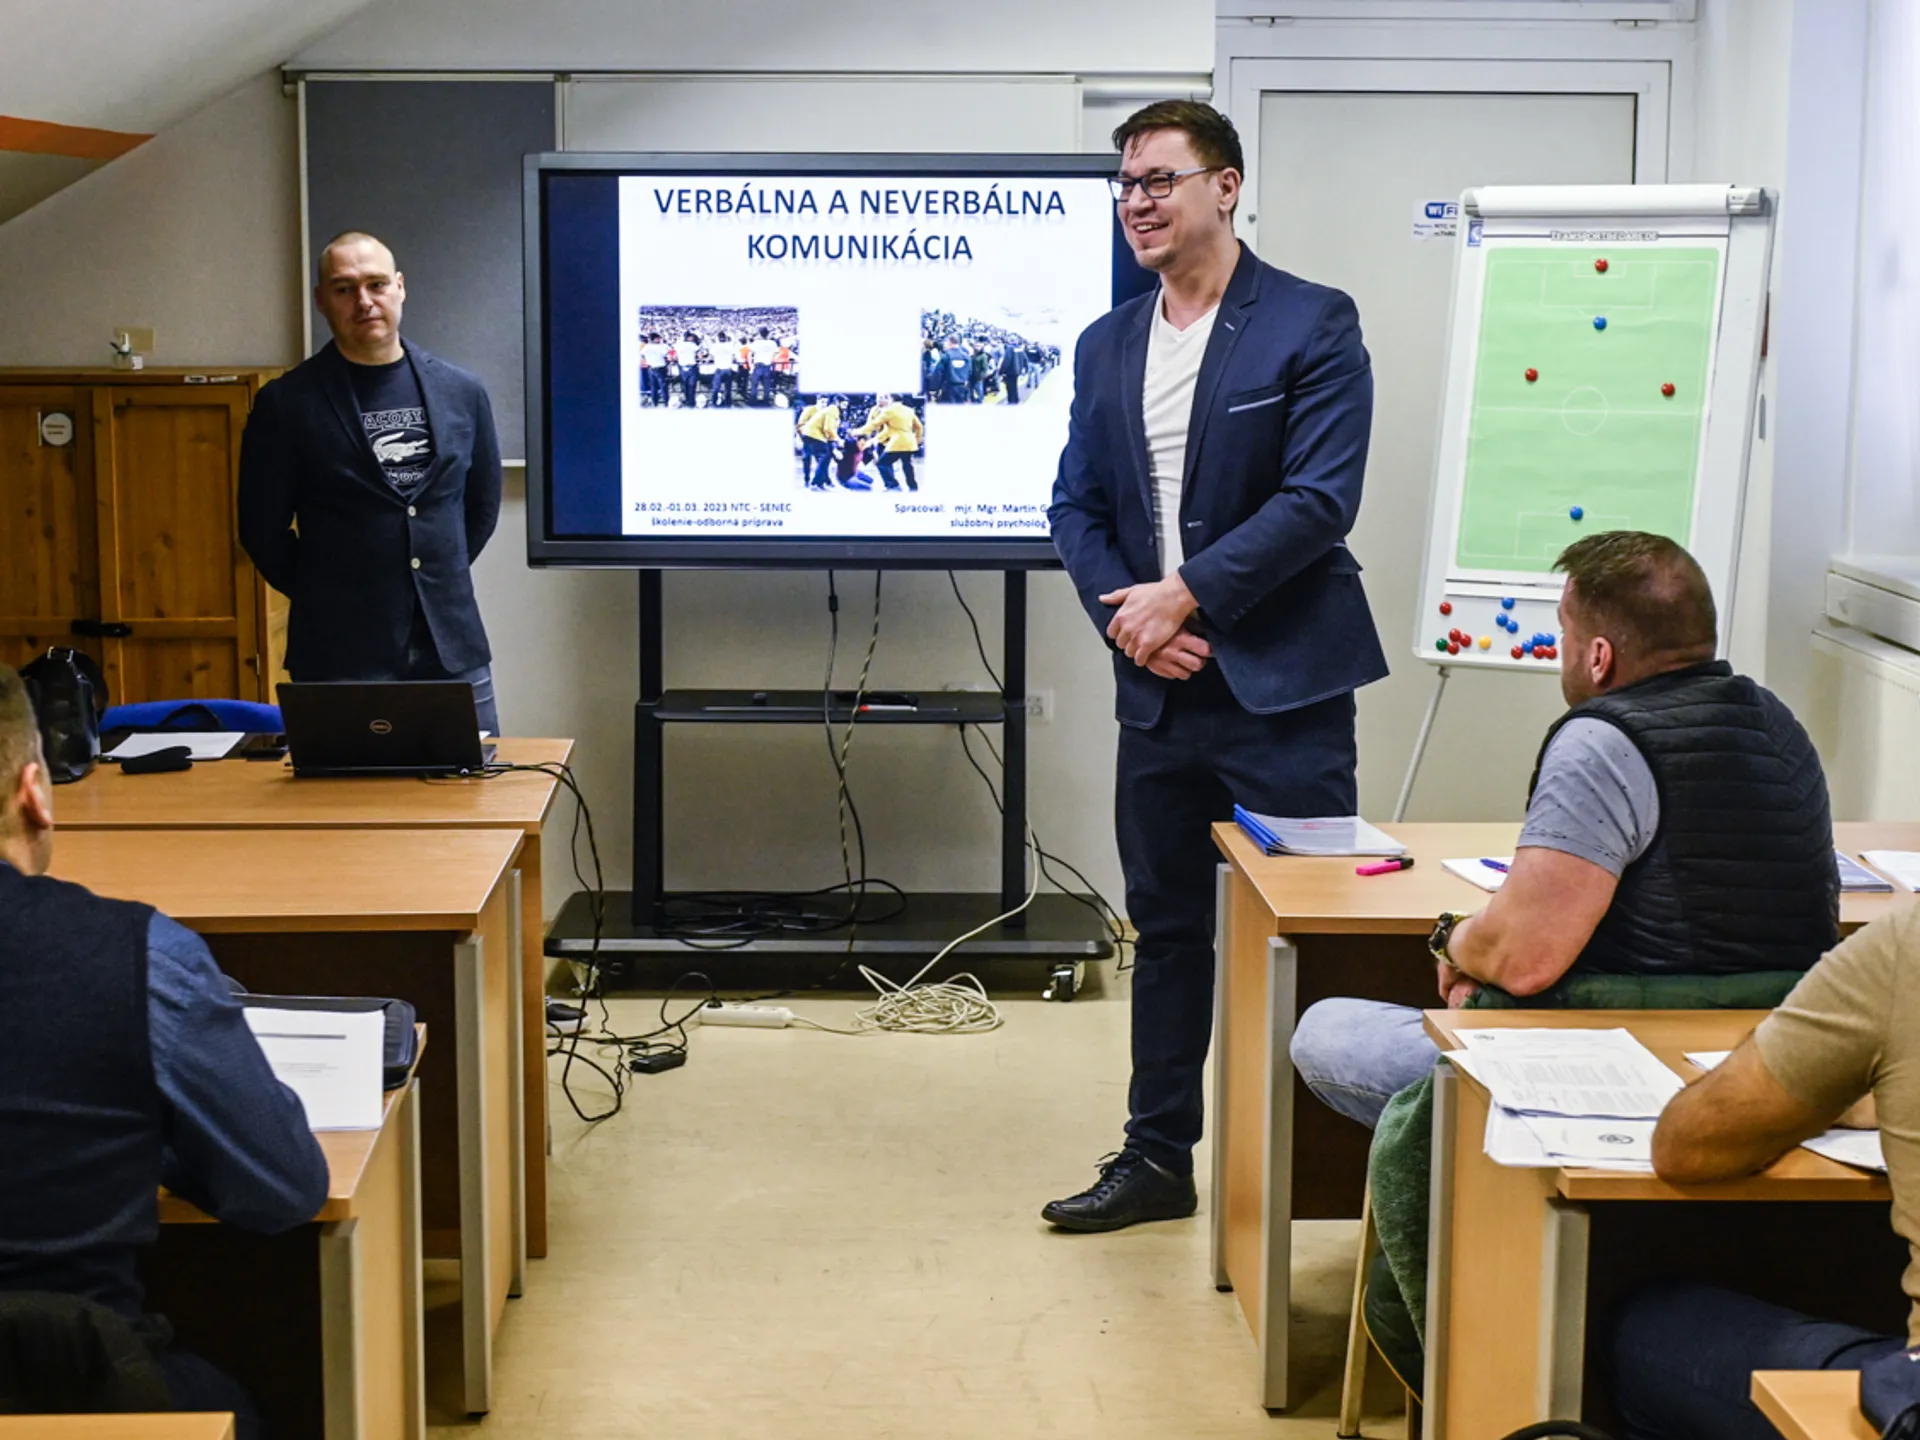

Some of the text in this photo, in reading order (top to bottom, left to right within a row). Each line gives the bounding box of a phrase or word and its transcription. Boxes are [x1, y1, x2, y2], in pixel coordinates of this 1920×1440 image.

[654, 183, 1065, 214] VERBÁLNA A NEVERBÁLNA
[749, 229, 972, 260] KOMUNIKÁCIA
[703, 502, 728, 512] 2023
[731, 503, 750, 512] NTC
[760, 503, 791, 512] SENEC
[976, 504, 1000, 515] Mgr.
[1002, 504, 1037, 513] Martin
[1040, 504, 1047, 514] G
